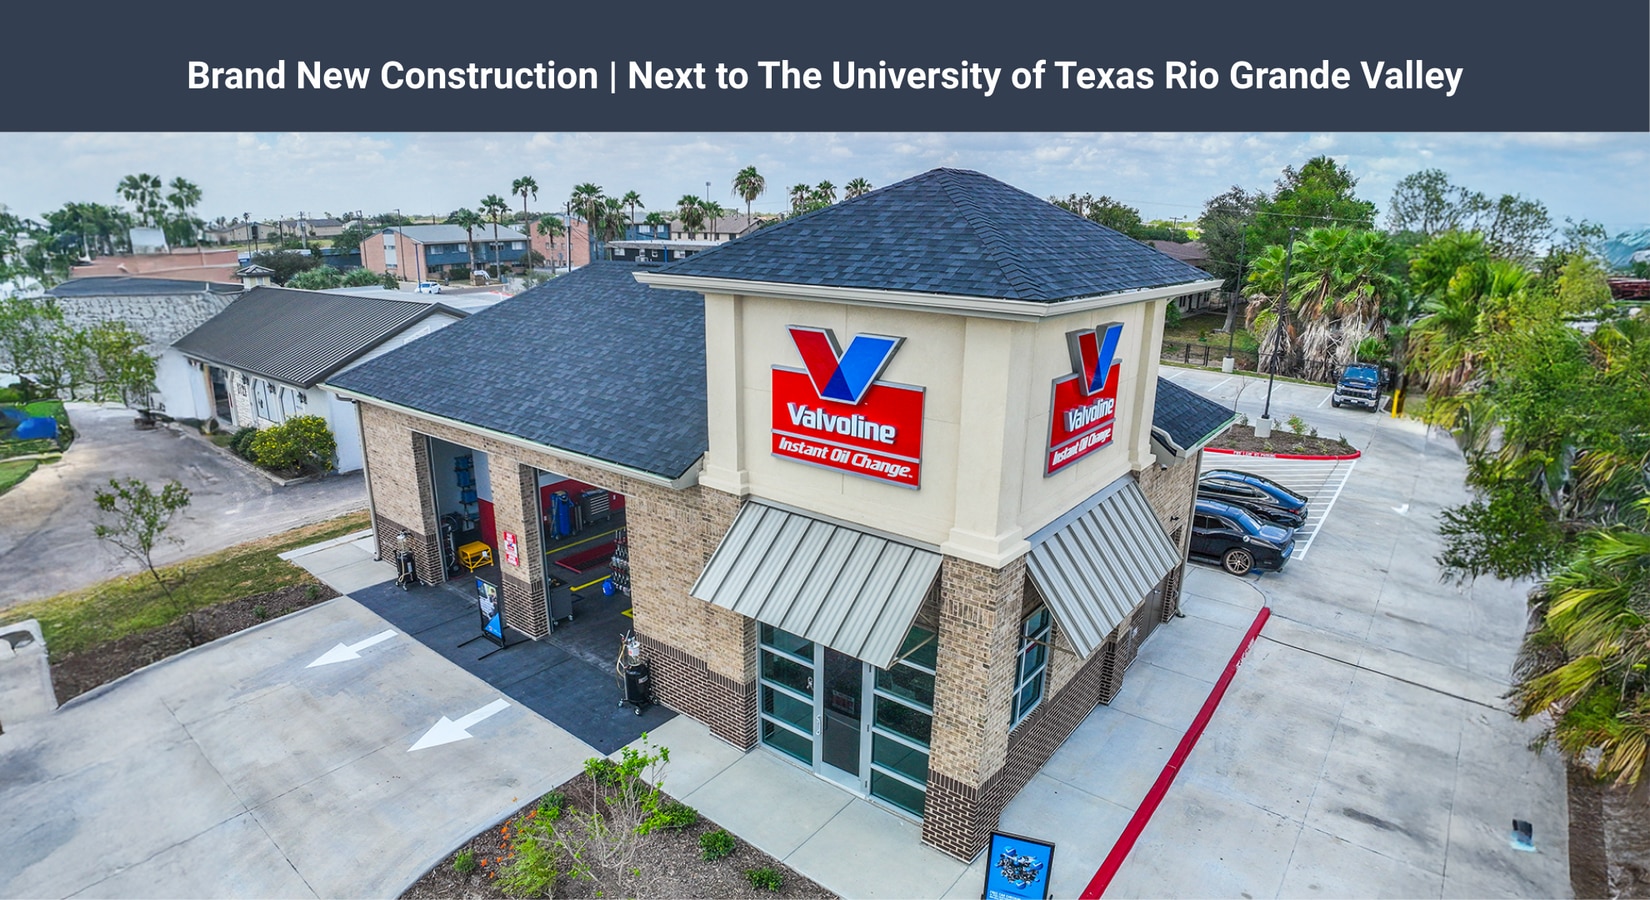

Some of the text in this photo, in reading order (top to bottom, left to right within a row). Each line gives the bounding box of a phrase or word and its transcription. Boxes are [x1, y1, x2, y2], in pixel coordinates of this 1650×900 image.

[787, 402, 897, 445] Valvoline
[1066, 398, 1115, 432] Valvoline
[778, 437, 829, 460] Instant
[830, 448, 851, 464] Oil
[1052, 442, 1080, 466] Instant
[1078, 434, 1089, 452] Oil
